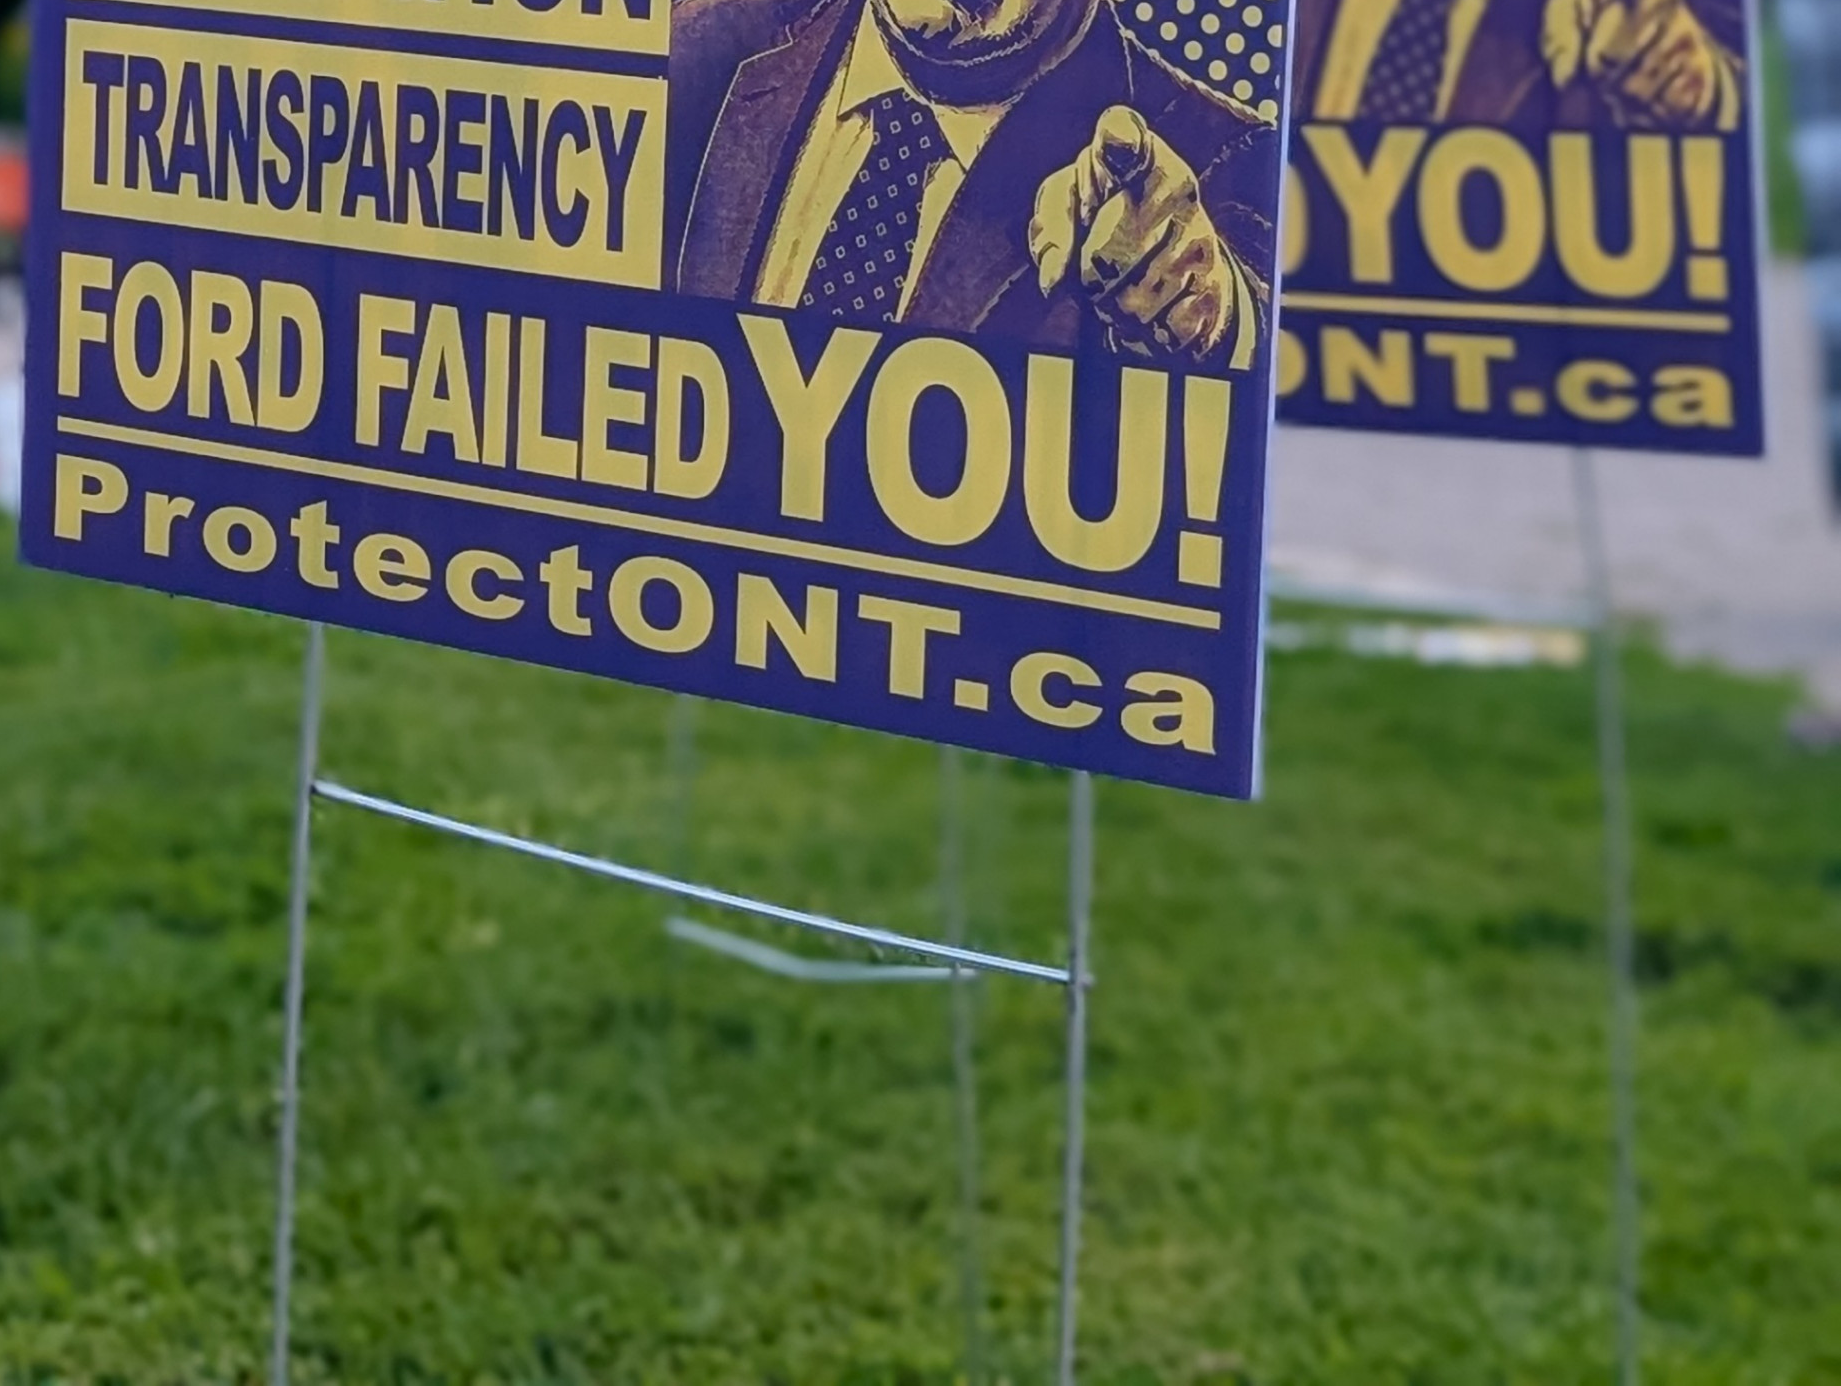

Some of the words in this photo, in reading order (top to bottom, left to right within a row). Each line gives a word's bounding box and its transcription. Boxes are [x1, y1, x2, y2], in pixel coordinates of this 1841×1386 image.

[82, 49, 649, 254] TRANSPARENCY
[1301, 125, 1729, 301] YOU!
[57, 251, 325, 433] FORD
[355, 293, 730, 501] FAILED
[735, 312, 1233, 589] YOU!
[52, 452, 1219, 757] ProtectONT.ca
